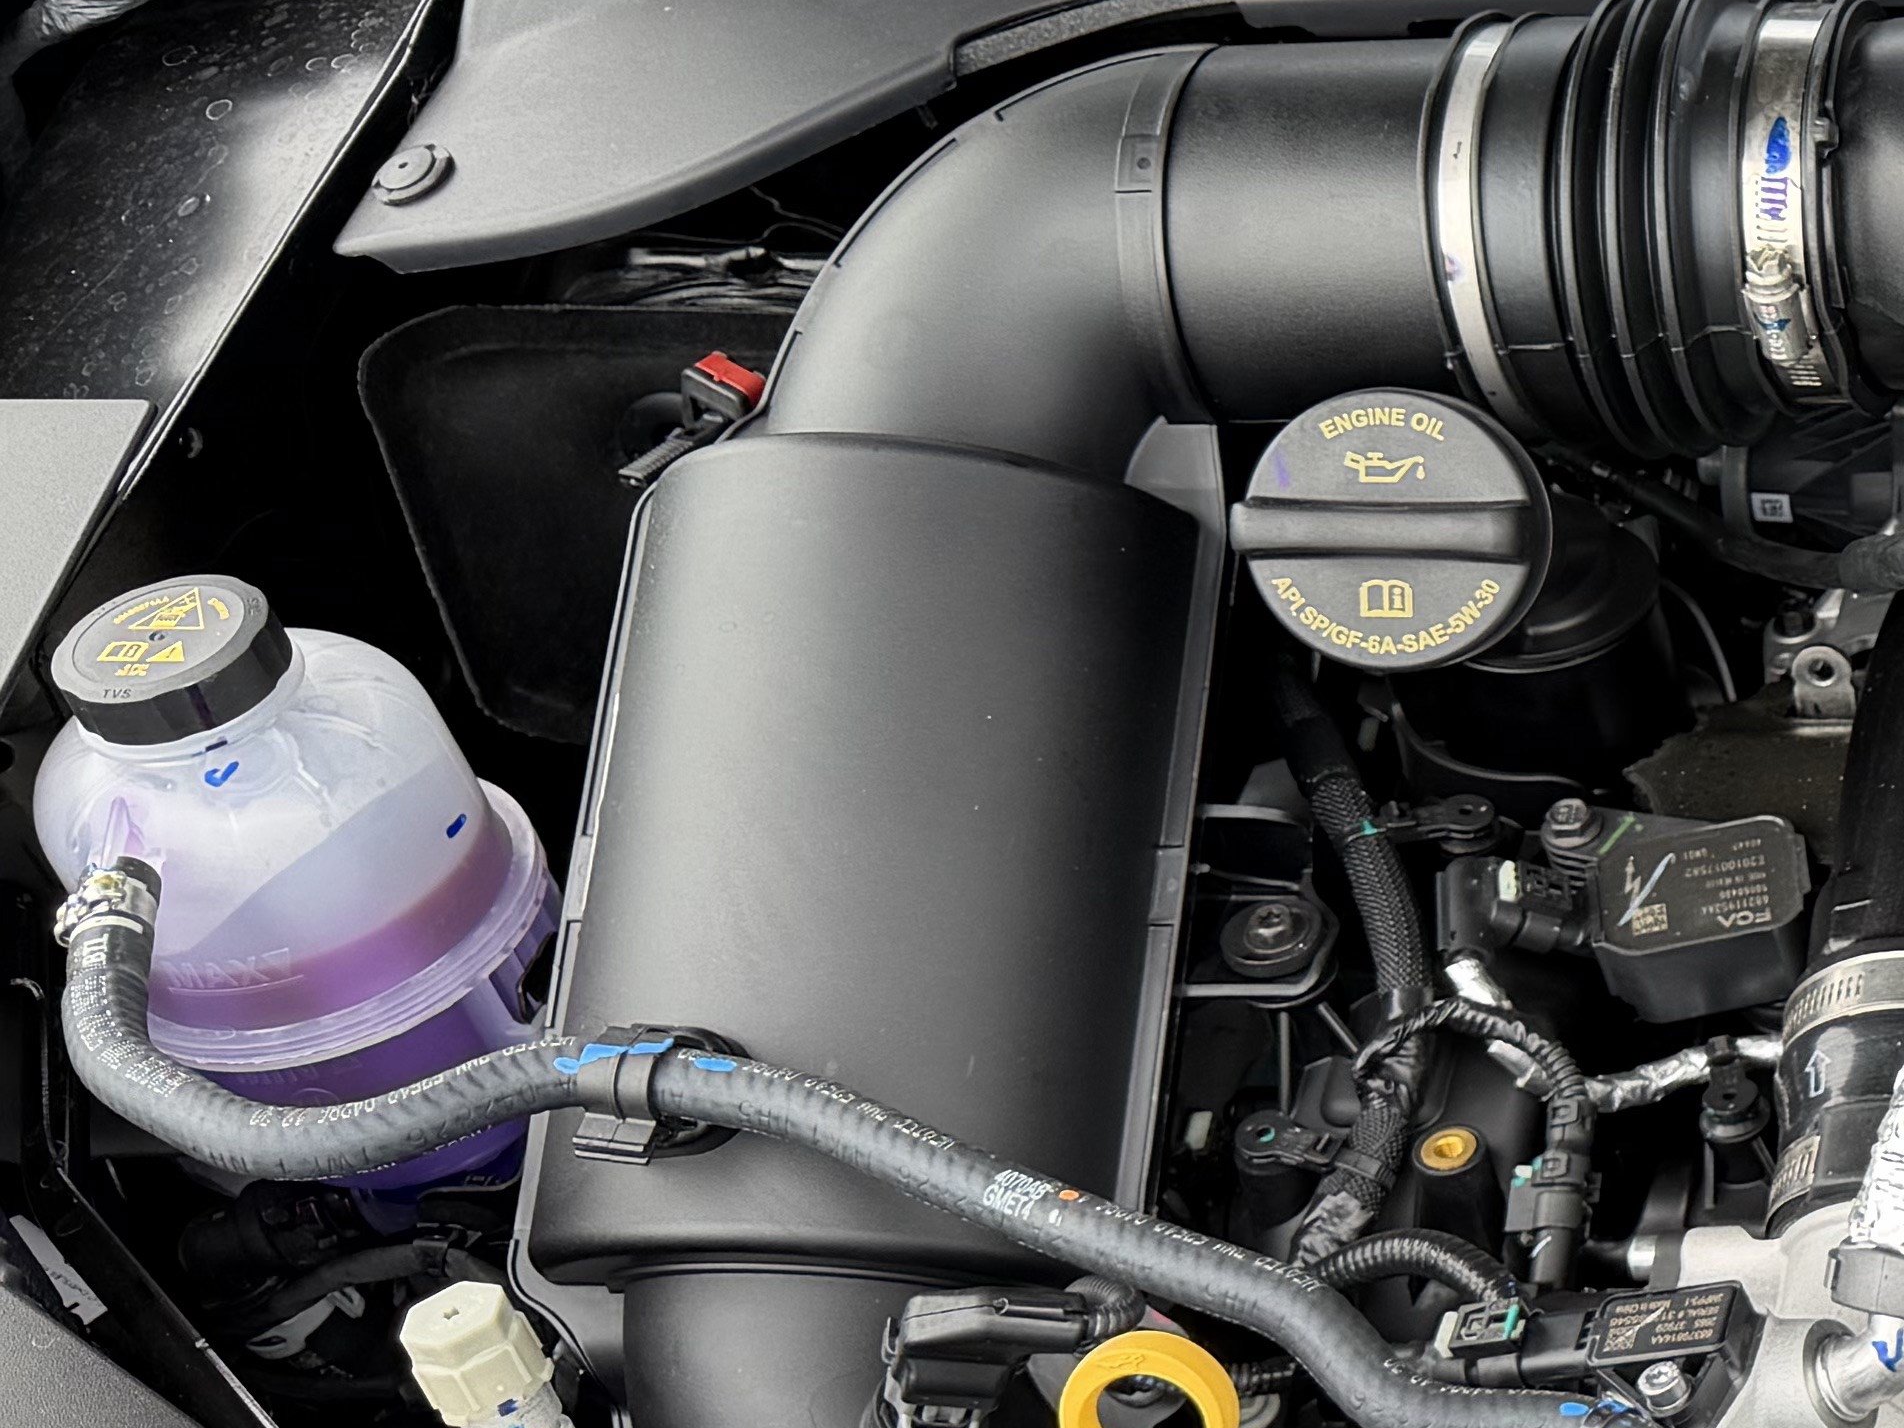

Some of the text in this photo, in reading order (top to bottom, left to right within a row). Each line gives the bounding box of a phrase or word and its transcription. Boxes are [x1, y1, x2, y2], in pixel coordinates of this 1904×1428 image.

[1318, 407, 1445, 442] ENGINE OIL
[103, 688, 133, 699] TVS
[1716, 906, 1773, 929] FCA
